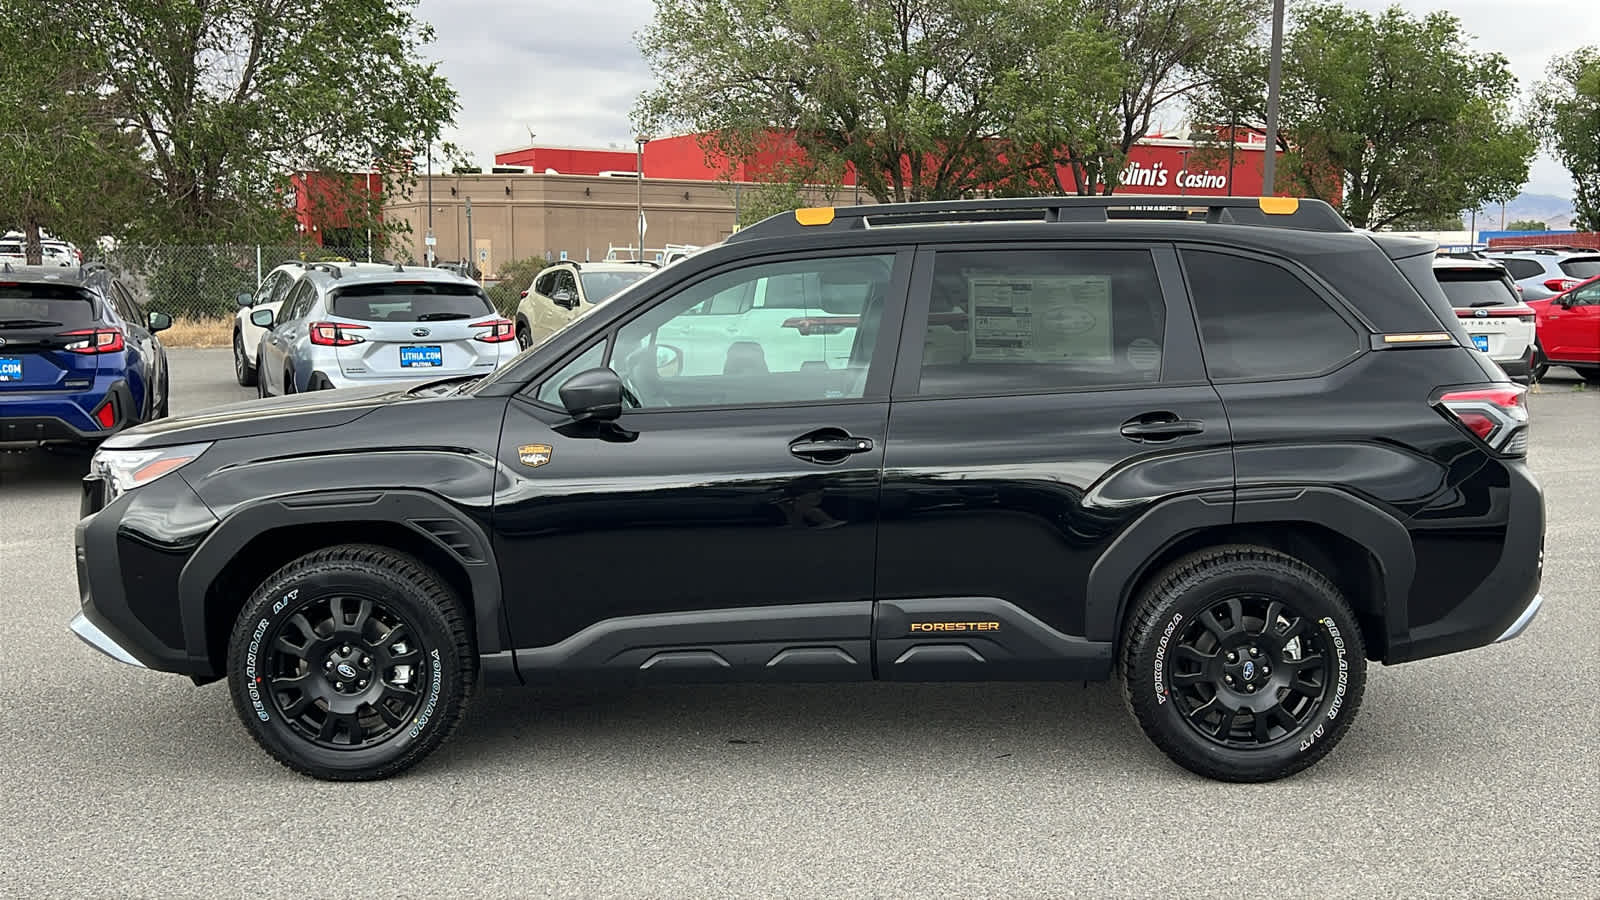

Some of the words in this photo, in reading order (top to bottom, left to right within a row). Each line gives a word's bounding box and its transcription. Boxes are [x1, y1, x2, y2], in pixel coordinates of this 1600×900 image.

[1176, 170, 1226, 188] Casino
[401, 352, 441, 361] LITHIA.COM
[246, 618, 270, 722] GEOLANDAR
[272, 588, 299, 614] A/T
[911, 622, 1000, 632] FORESTER
[1154, 612, 1183, 704] YOKOHAMA
[1322, 616, 1348, 720] GEOLANDAR
[409, 648, 442, 738] YOKOHAMA
[1299, 724, 1325, 751] A/T
